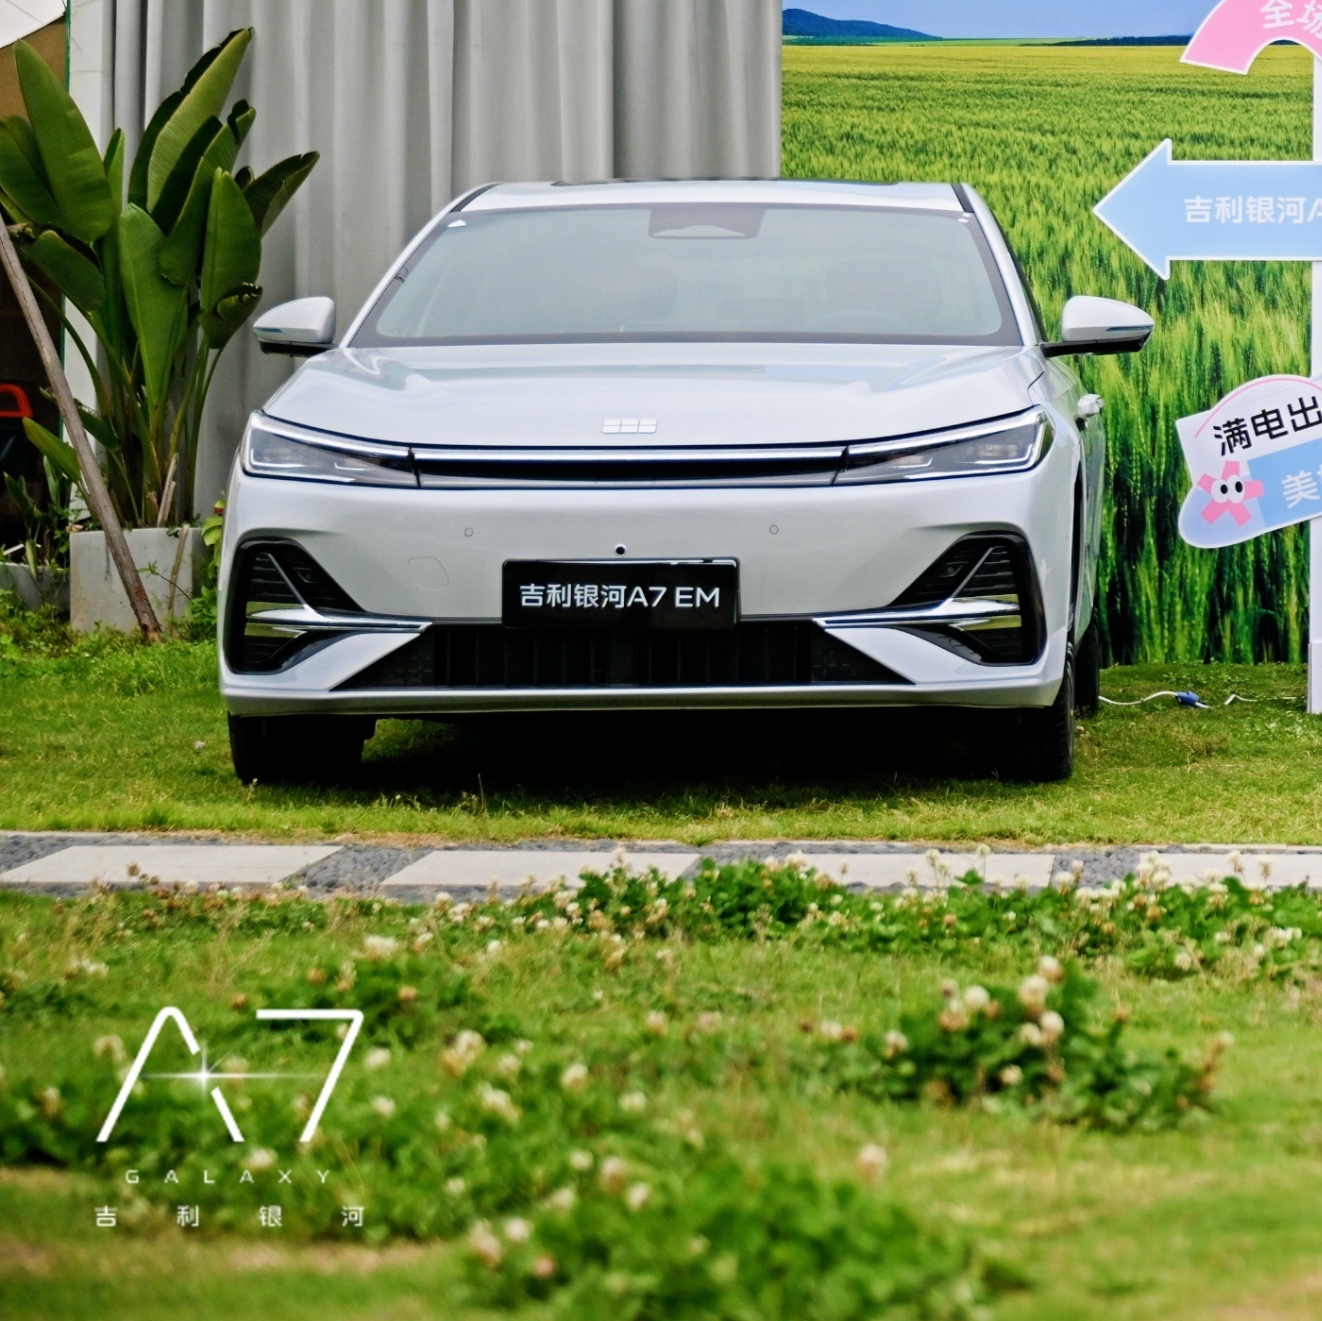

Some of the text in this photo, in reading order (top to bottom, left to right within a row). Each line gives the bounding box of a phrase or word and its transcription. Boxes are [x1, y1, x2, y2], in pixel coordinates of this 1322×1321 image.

[519, 583, 721, 609] 吉利银河A7 EM
